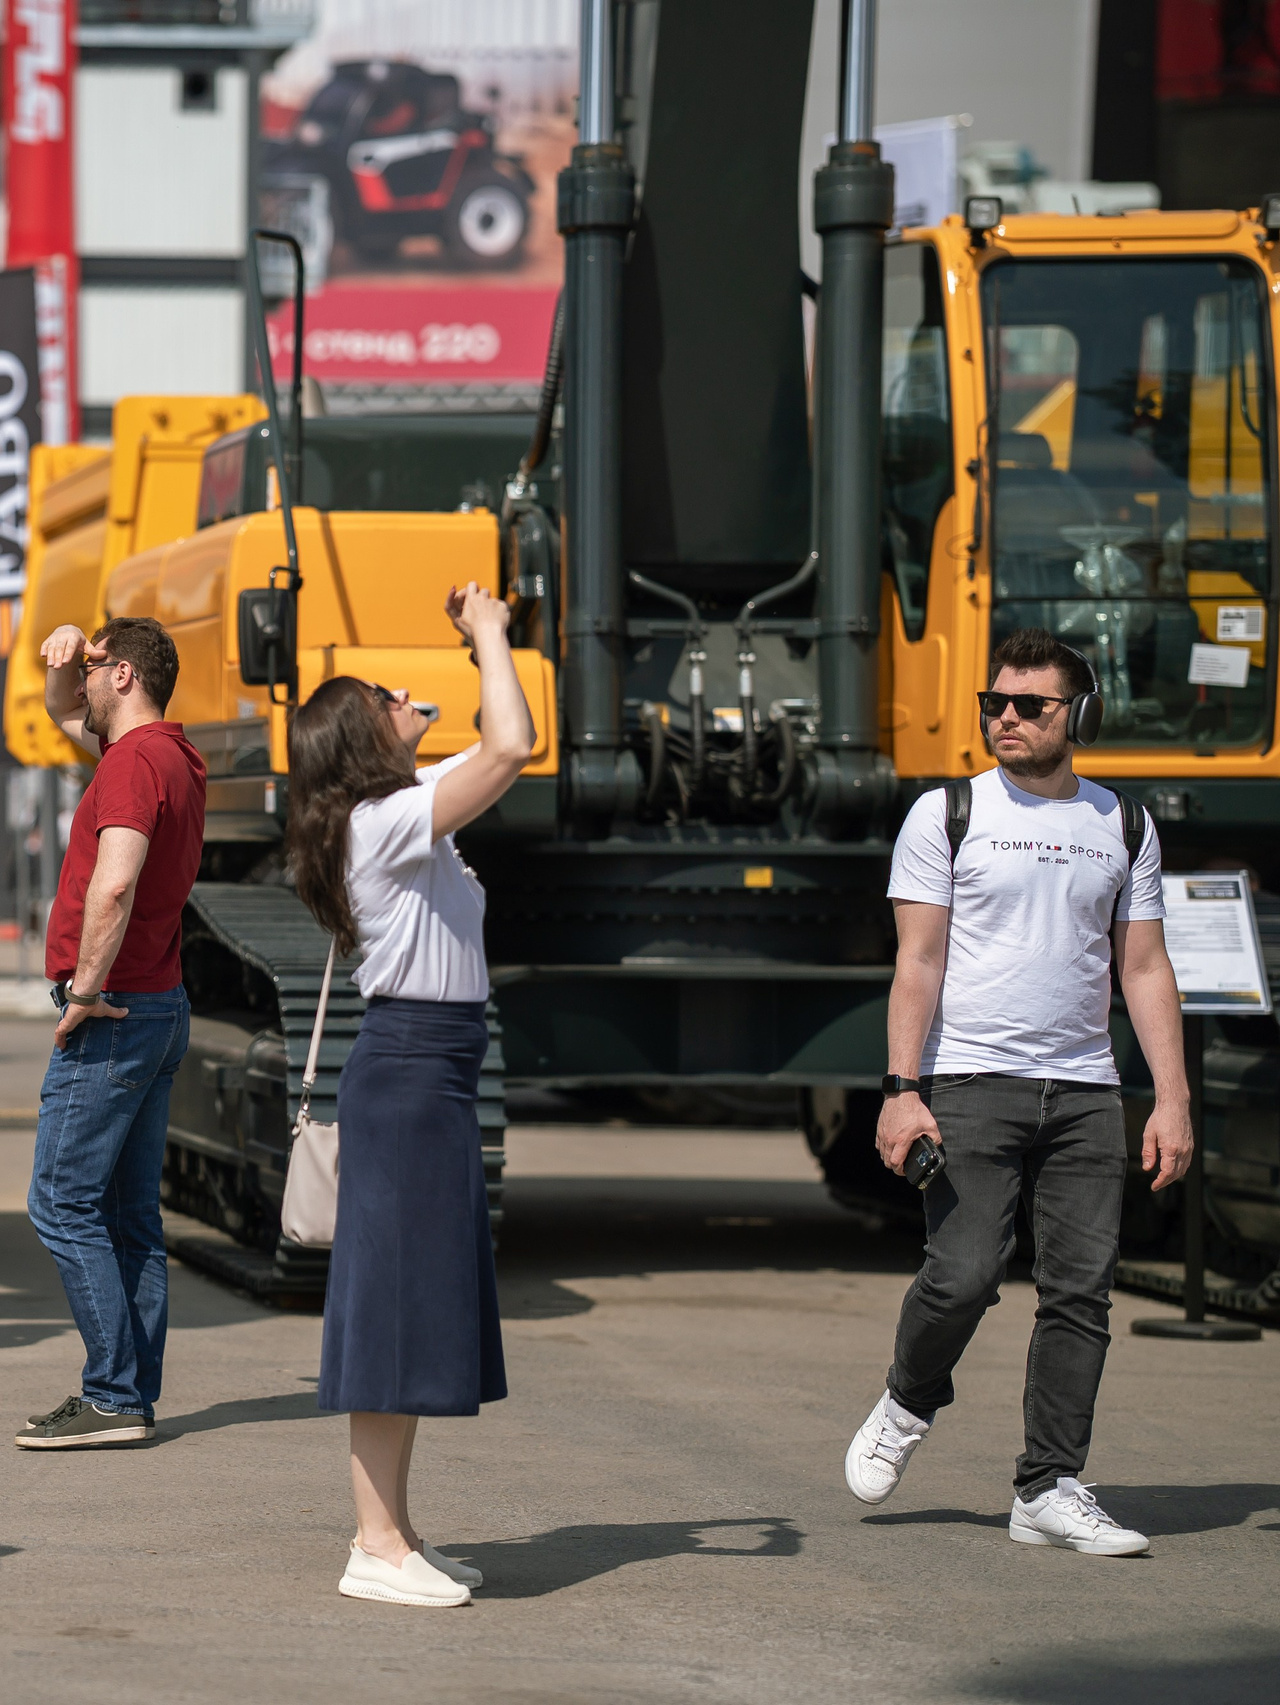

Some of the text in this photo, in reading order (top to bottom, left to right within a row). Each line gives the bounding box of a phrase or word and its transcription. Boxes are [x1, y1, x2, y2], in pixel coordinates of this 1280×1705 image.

[420, 323, 500, 363] 220
[990, 840, 1113, 863] TOMMY SPORT
